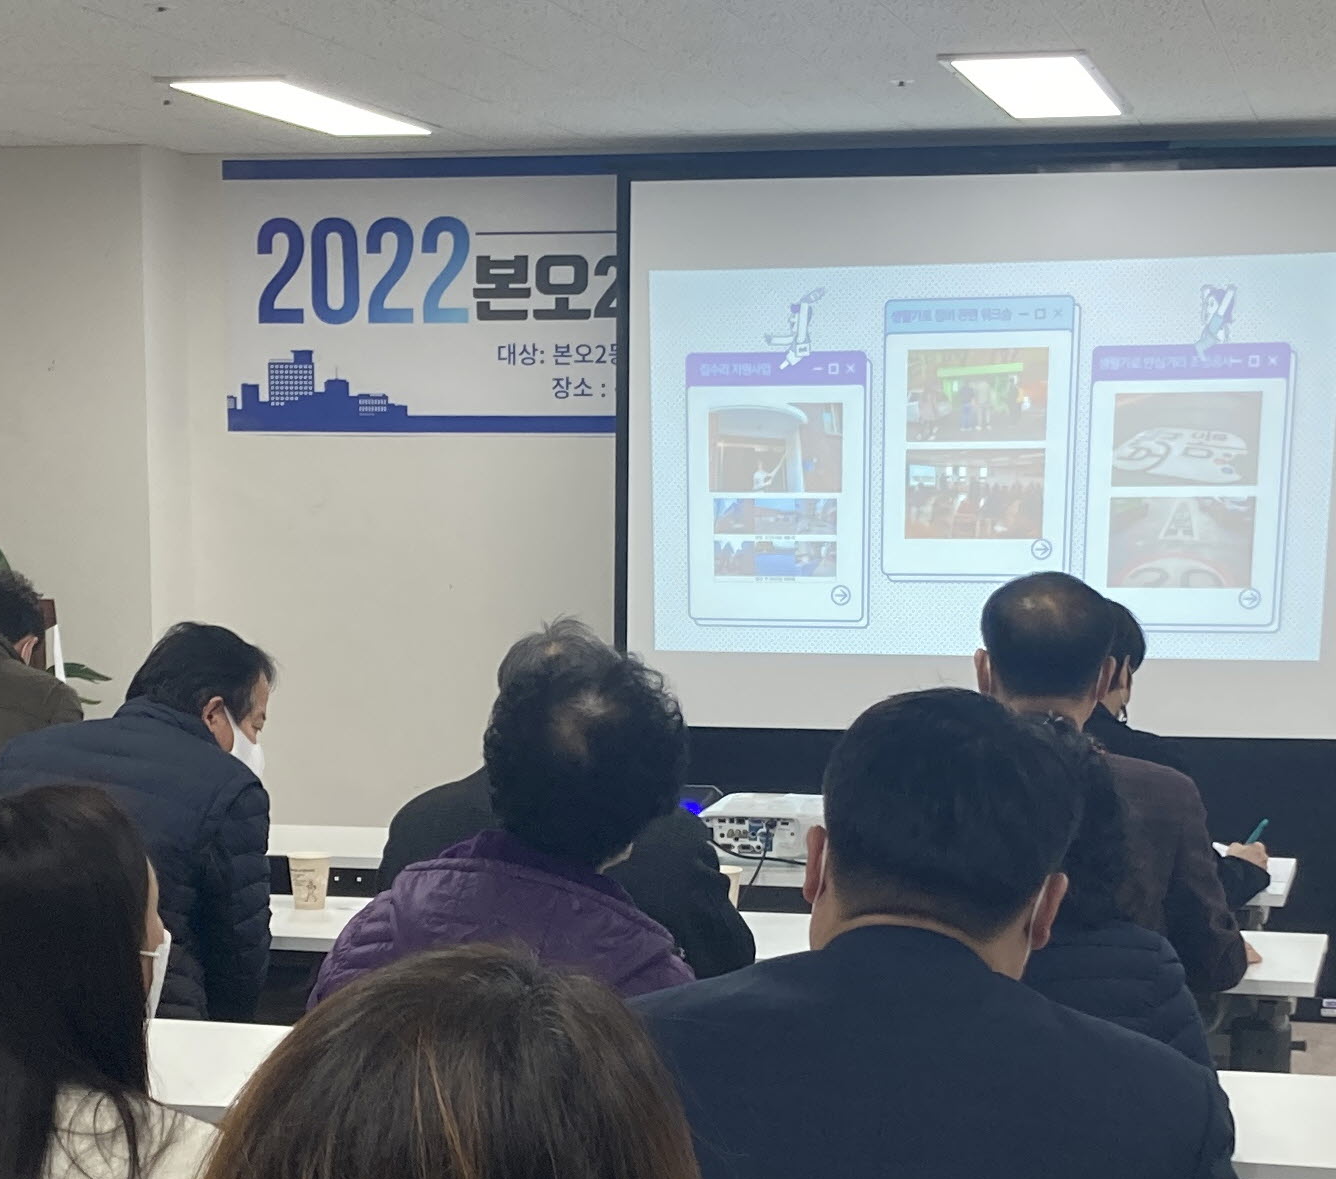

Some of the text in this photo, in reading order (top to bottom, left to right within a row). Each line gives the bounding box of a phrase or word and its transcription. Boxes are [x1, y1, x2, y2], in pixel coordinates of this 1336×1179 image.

[257, 216, 470, 325] 2022
[497, 343, 545, 366] 대상:
[552, 376, 593, 399] 장소
